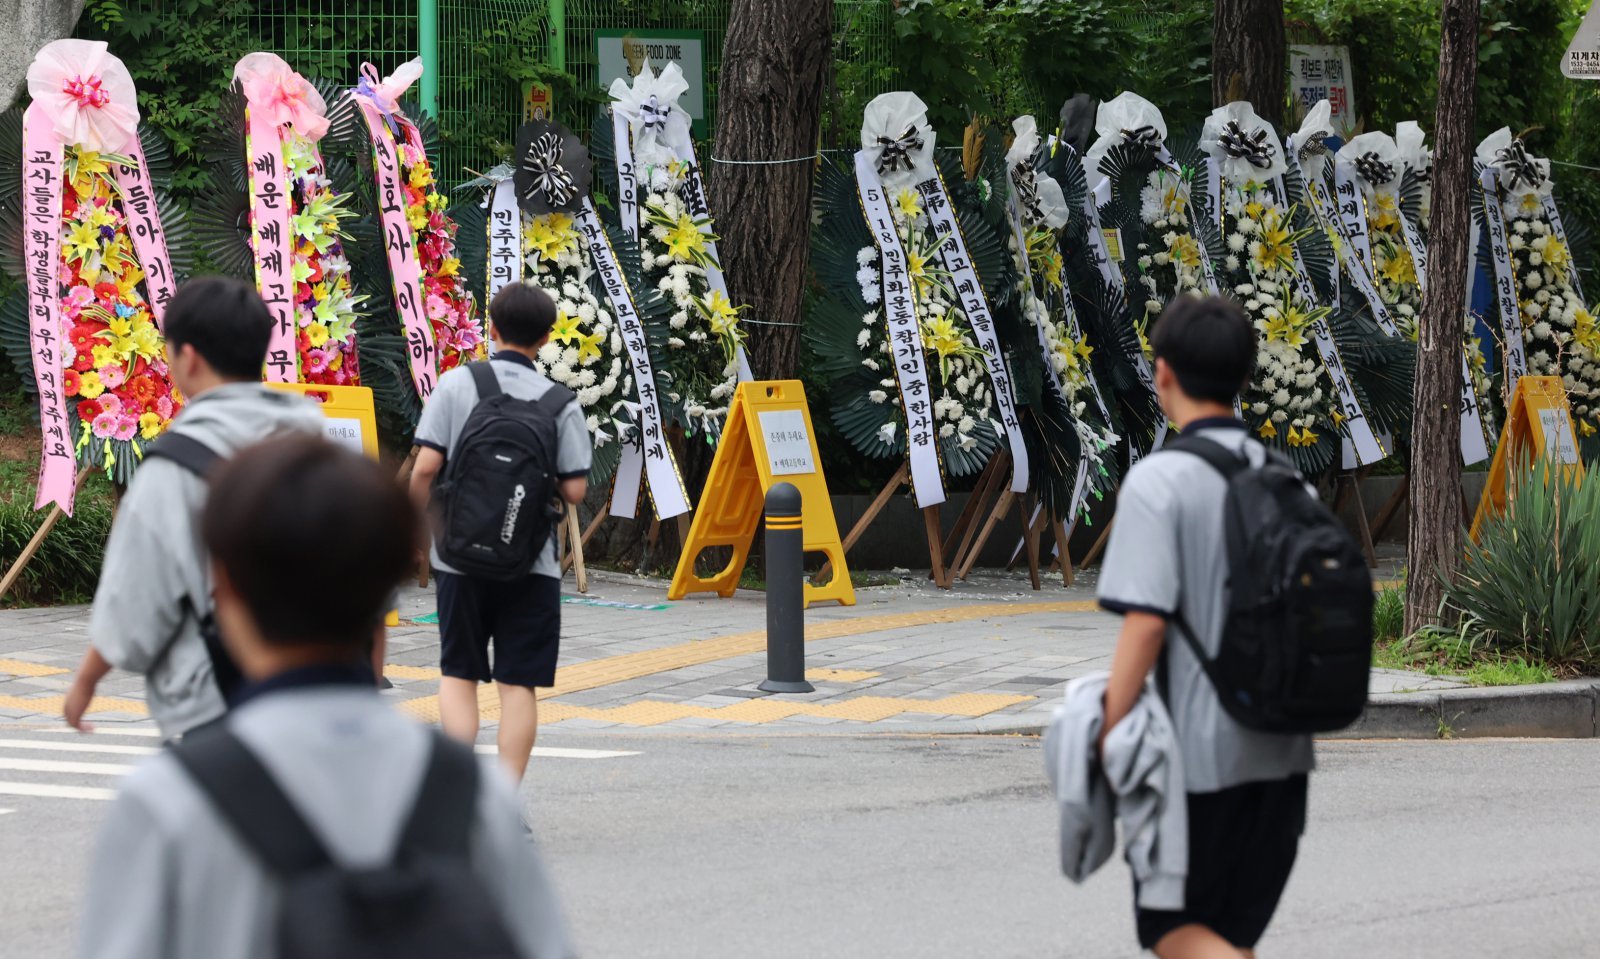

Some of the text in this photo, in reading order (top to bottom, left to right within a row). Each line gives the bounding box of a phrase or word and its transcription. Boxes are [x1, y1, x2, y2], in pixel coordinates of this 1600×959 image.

[646, 45, 664, 59] FOOD
[665, 45, 682, 60] ZONE
[1330, 86, 1348, 117] 금지
[253, 152, 283, 209] 배운
[374, 135, 411, 263] 변호사
[1337, 180, 1365, 239] 배재고
[29, 150, 70, 459] 교사들은 학생들부터 우선 지켜주세요
[884, 249, 912, 326] 민주화운동
[1488, 204, 1508, 264] 철저한
[1499, 275, 1520, 336] 성찰과
[894, 329, 921, 374] 참가인
[935, 219, 969, 273] 배재고
[958, 279, 992, 332] 폐교를
[982, 338, 1018, 432] 애도합니다
[617, 303, 650, 375] 모욕하는
[640, 383, 664, 461] 국민에게
[904, 379, 926, 396] 중
[1325, 350, 1363, 421] 배재고
